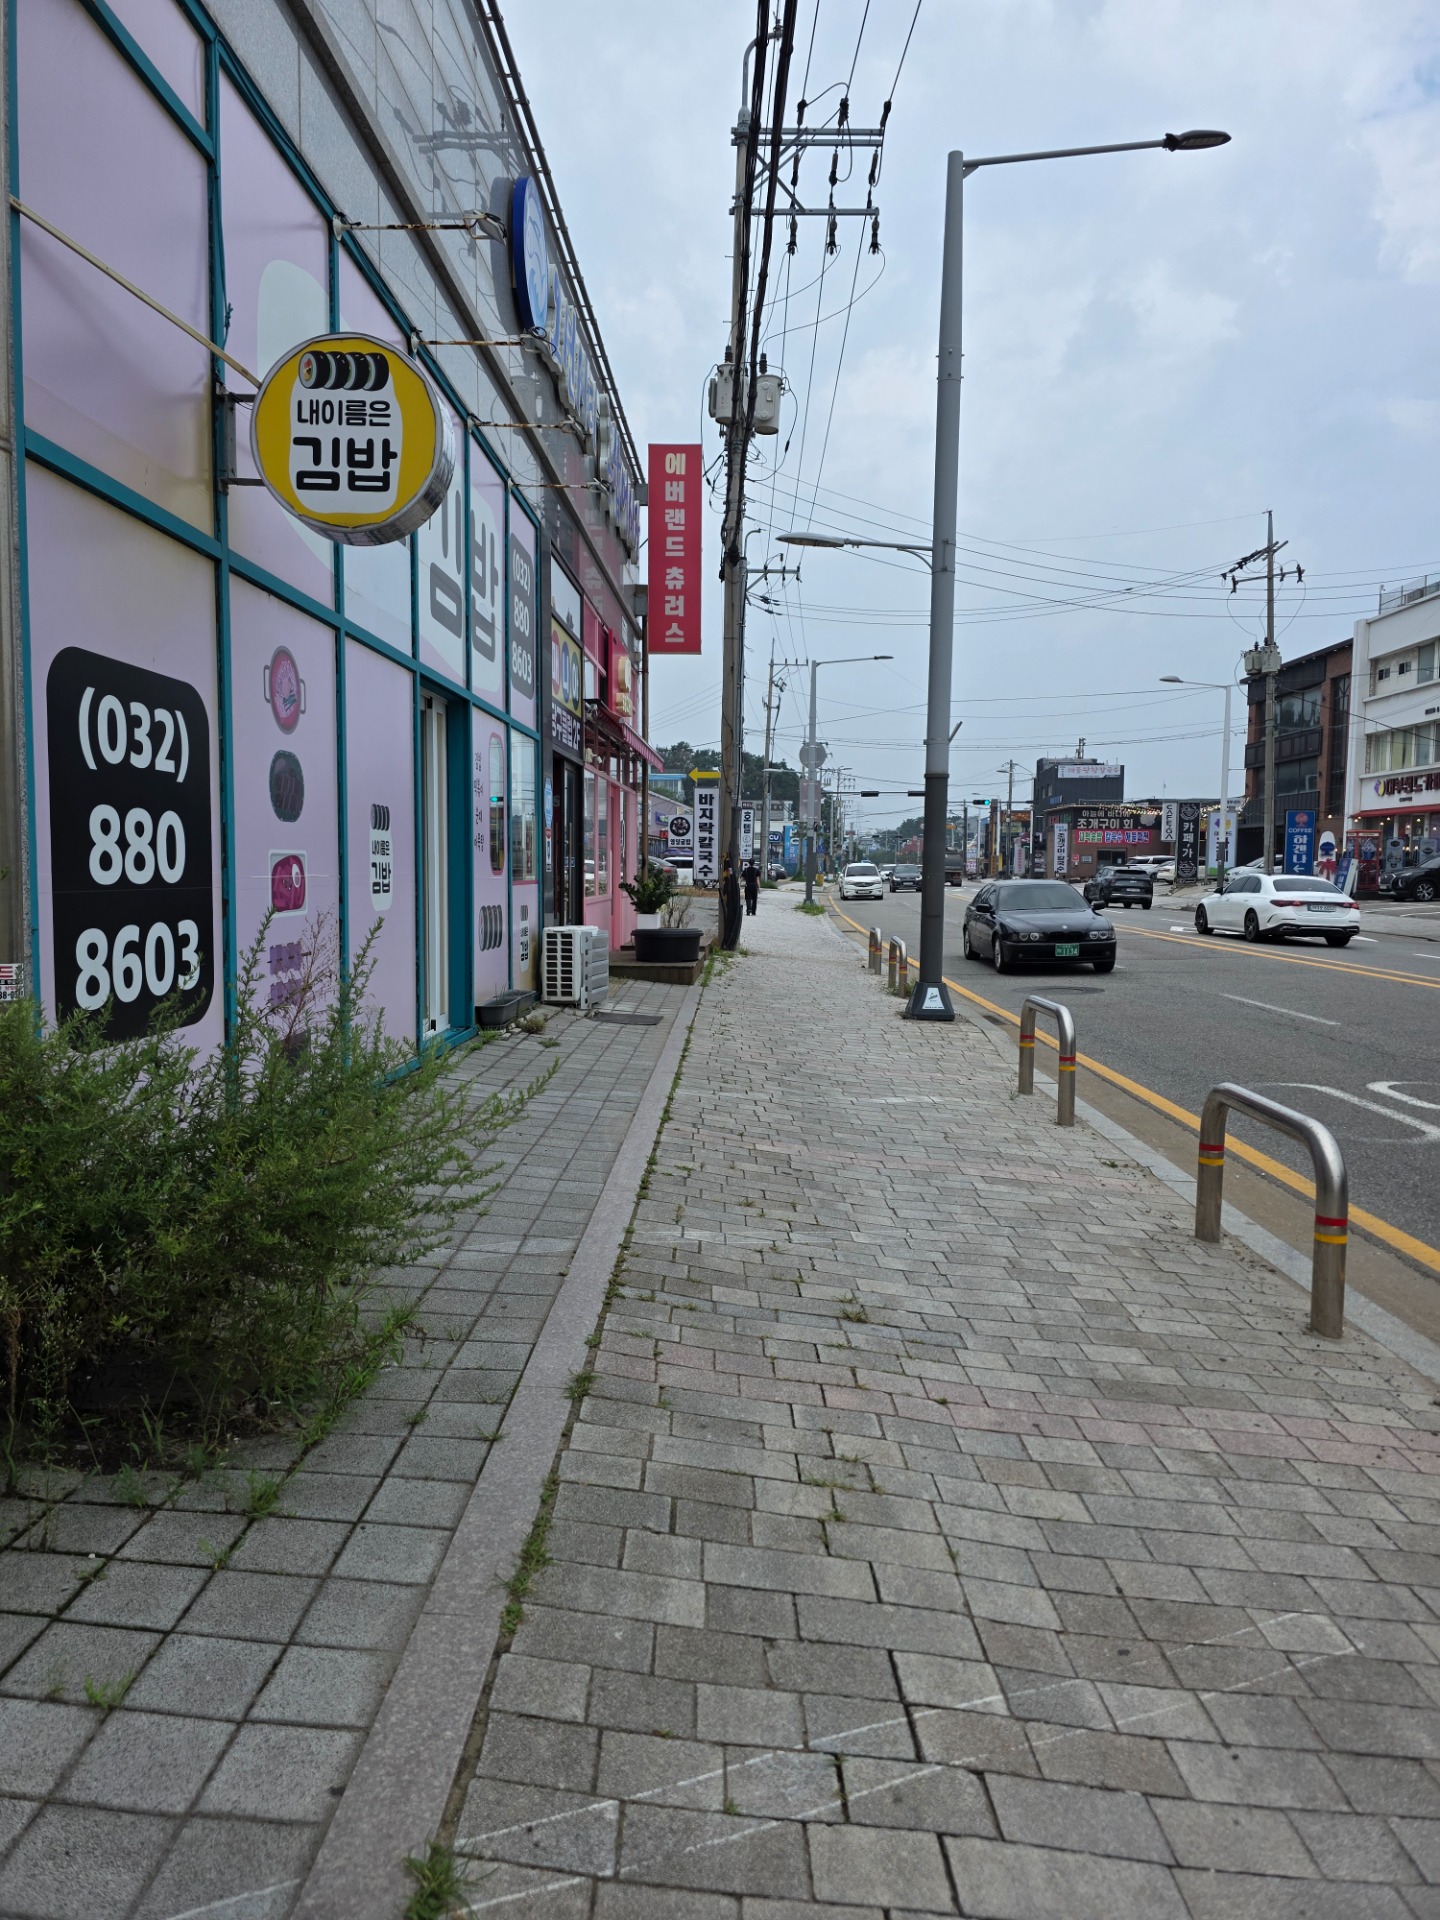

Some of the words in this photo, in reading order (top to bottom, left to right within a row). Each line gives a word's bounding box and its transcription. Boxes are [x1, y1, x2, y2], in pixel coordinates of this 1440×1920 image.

[296, 398, 392, 428] 내이름은
[293, 436, 398, 493] 김밥
[664, 452, 687, 558] 에버랜드
[512, 548, 531, 593] (032)
[513, 595, 530, 638] 880
[664, 566, 686, 643] 츄러스
[512, 643, 532, 685] 8603
[77, 684, 191, 784] (032)
[572, 722, 581, 751] 2F
[698, 793, 715, 877] 바지락칼국수
[743, 810, 752, 834] 호텔
[1077, 818, 1120, 829] 조개구이
[1123, 818, 1134, 829] 회
[88, 804, 187, 886] 880
[371, 838, 391, 857] 내이름은
[371, 861, 392, 895] 김밥
[74, 920, 202, 1011] 8603
